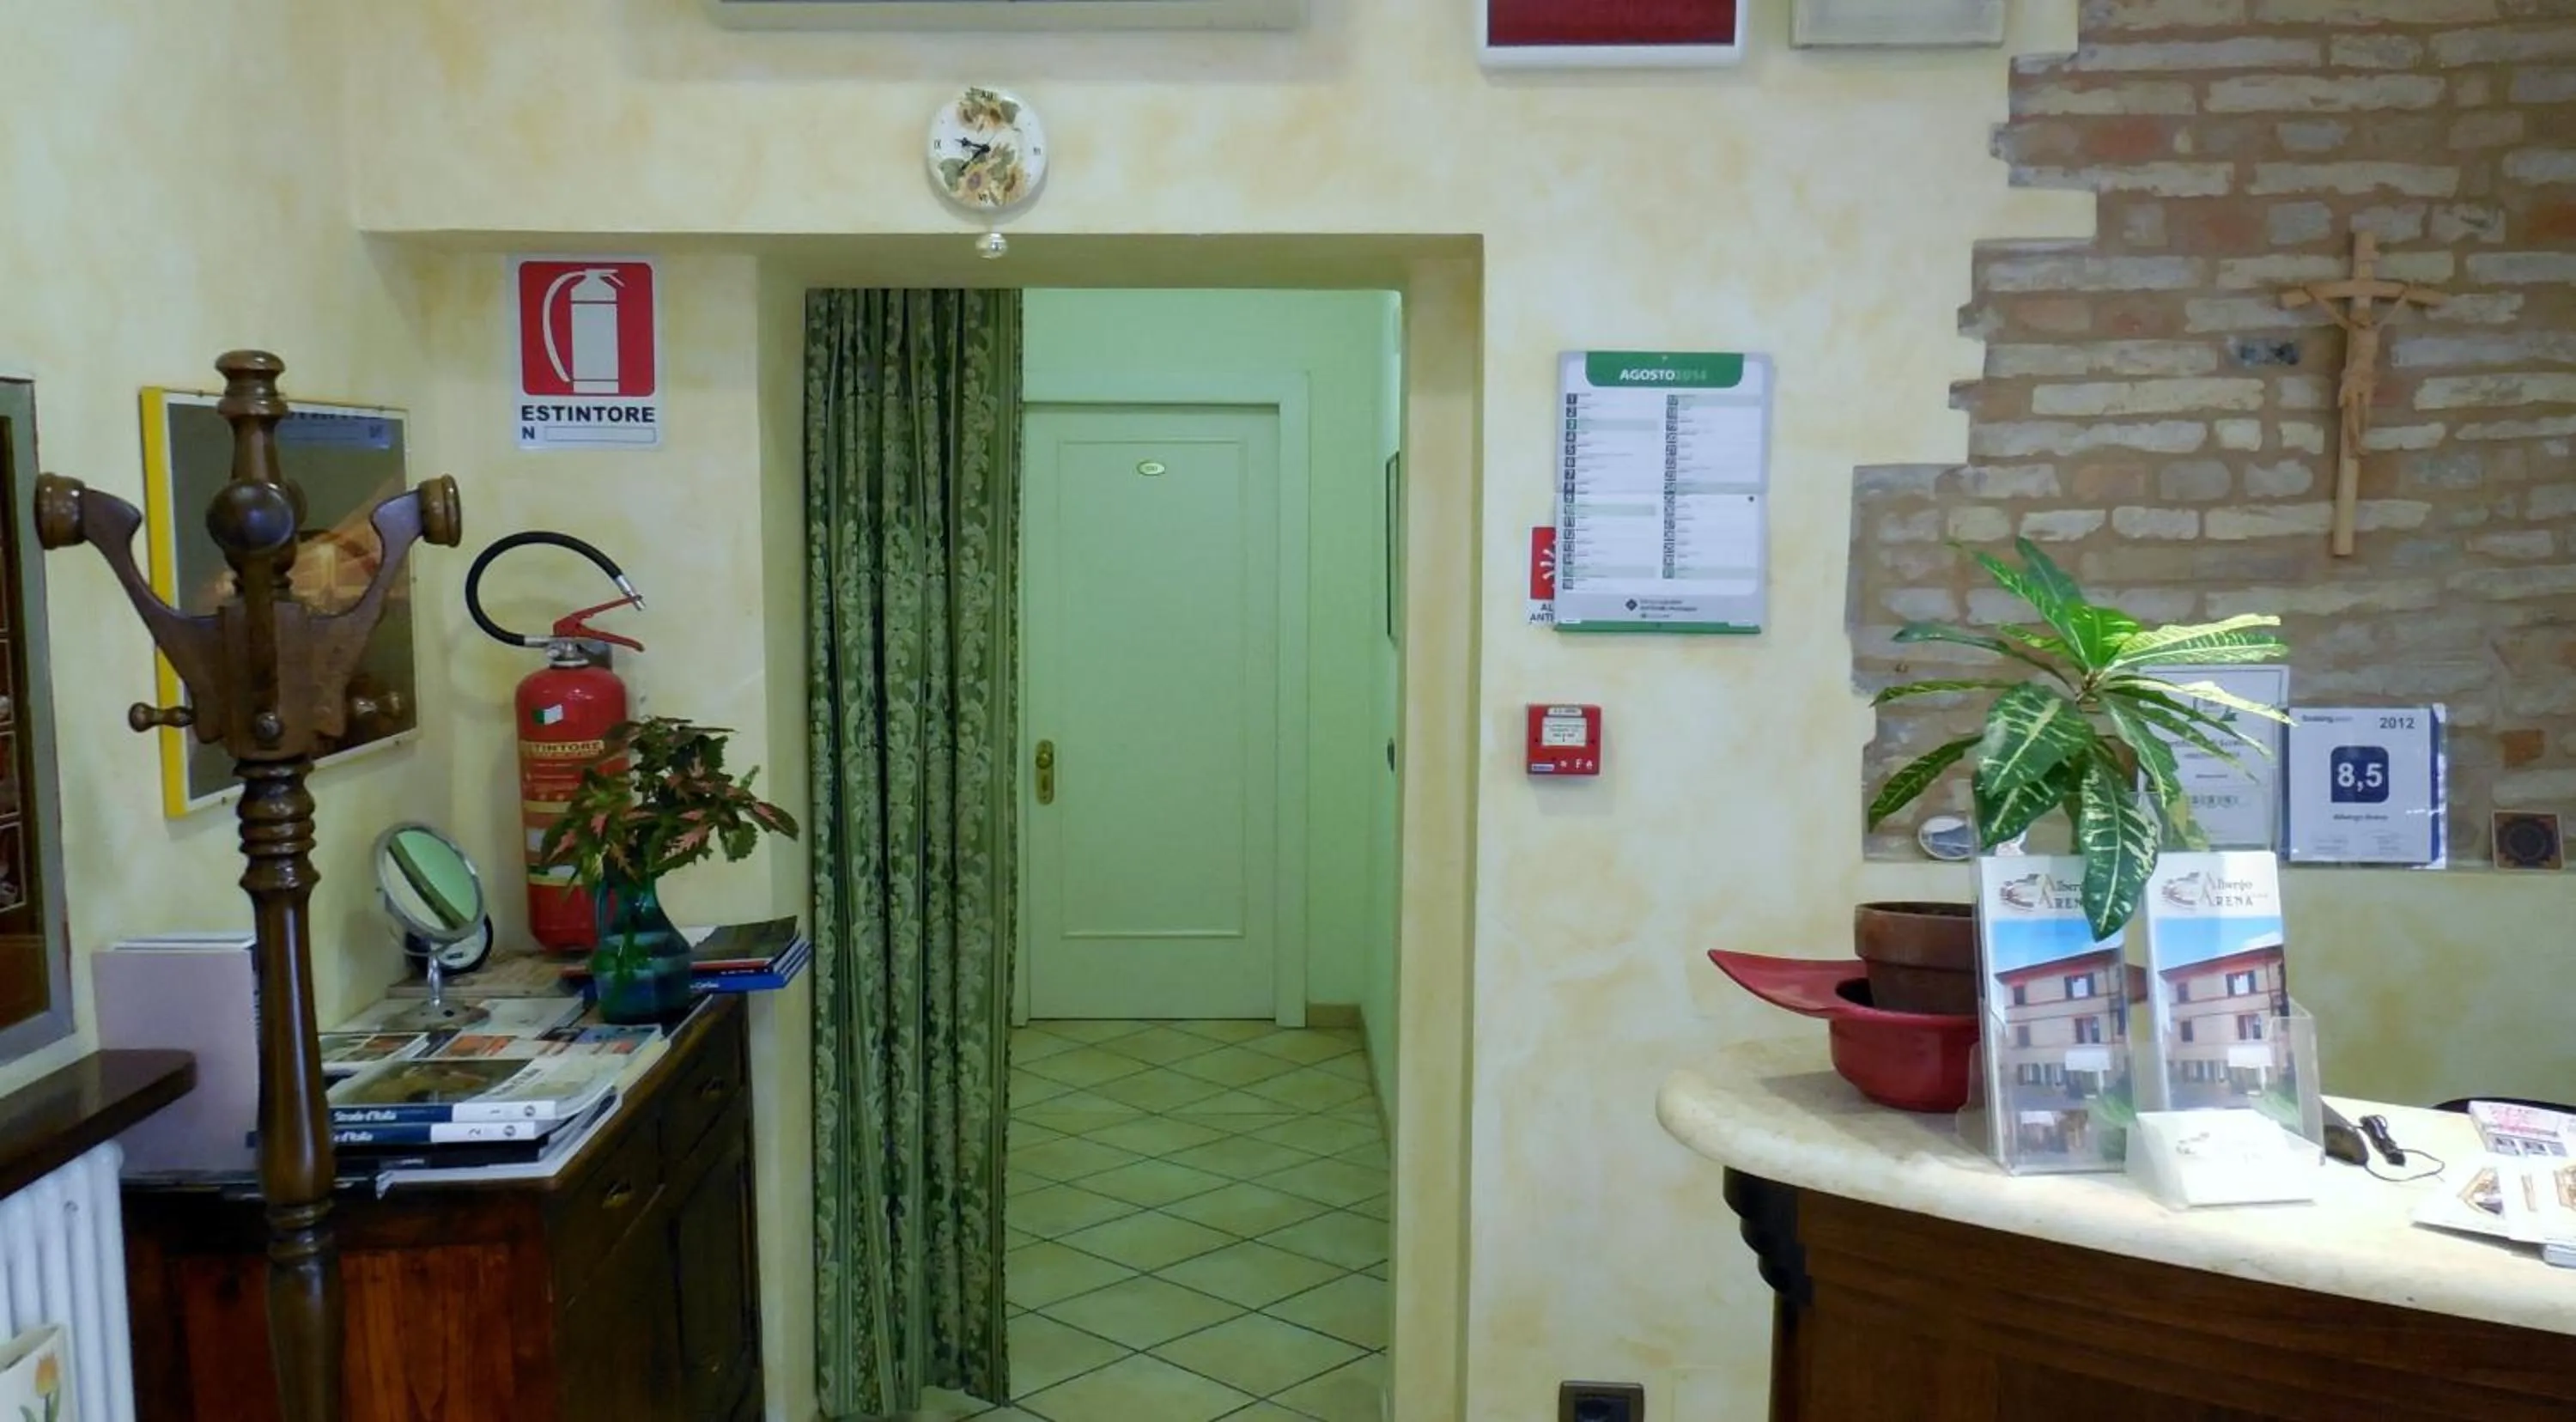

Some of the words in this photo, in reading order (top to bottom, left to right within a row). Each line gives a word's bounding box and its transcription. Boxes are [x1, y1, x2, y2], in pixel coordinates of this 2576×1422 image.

[1619, 368, 1675, 381] AGOSTO
[521, 405, 655, 422] ESTINTORE
[521, 426, 536, 440] N
[2379, 717, 2415, 729] 2012
[523, 743, 598, 753] TINTORE
[2337, 762, 2383, 793] 8,5
[2038, 888, 2084, 909] AREN
[2199, 886, 2254, 907] ARENA
